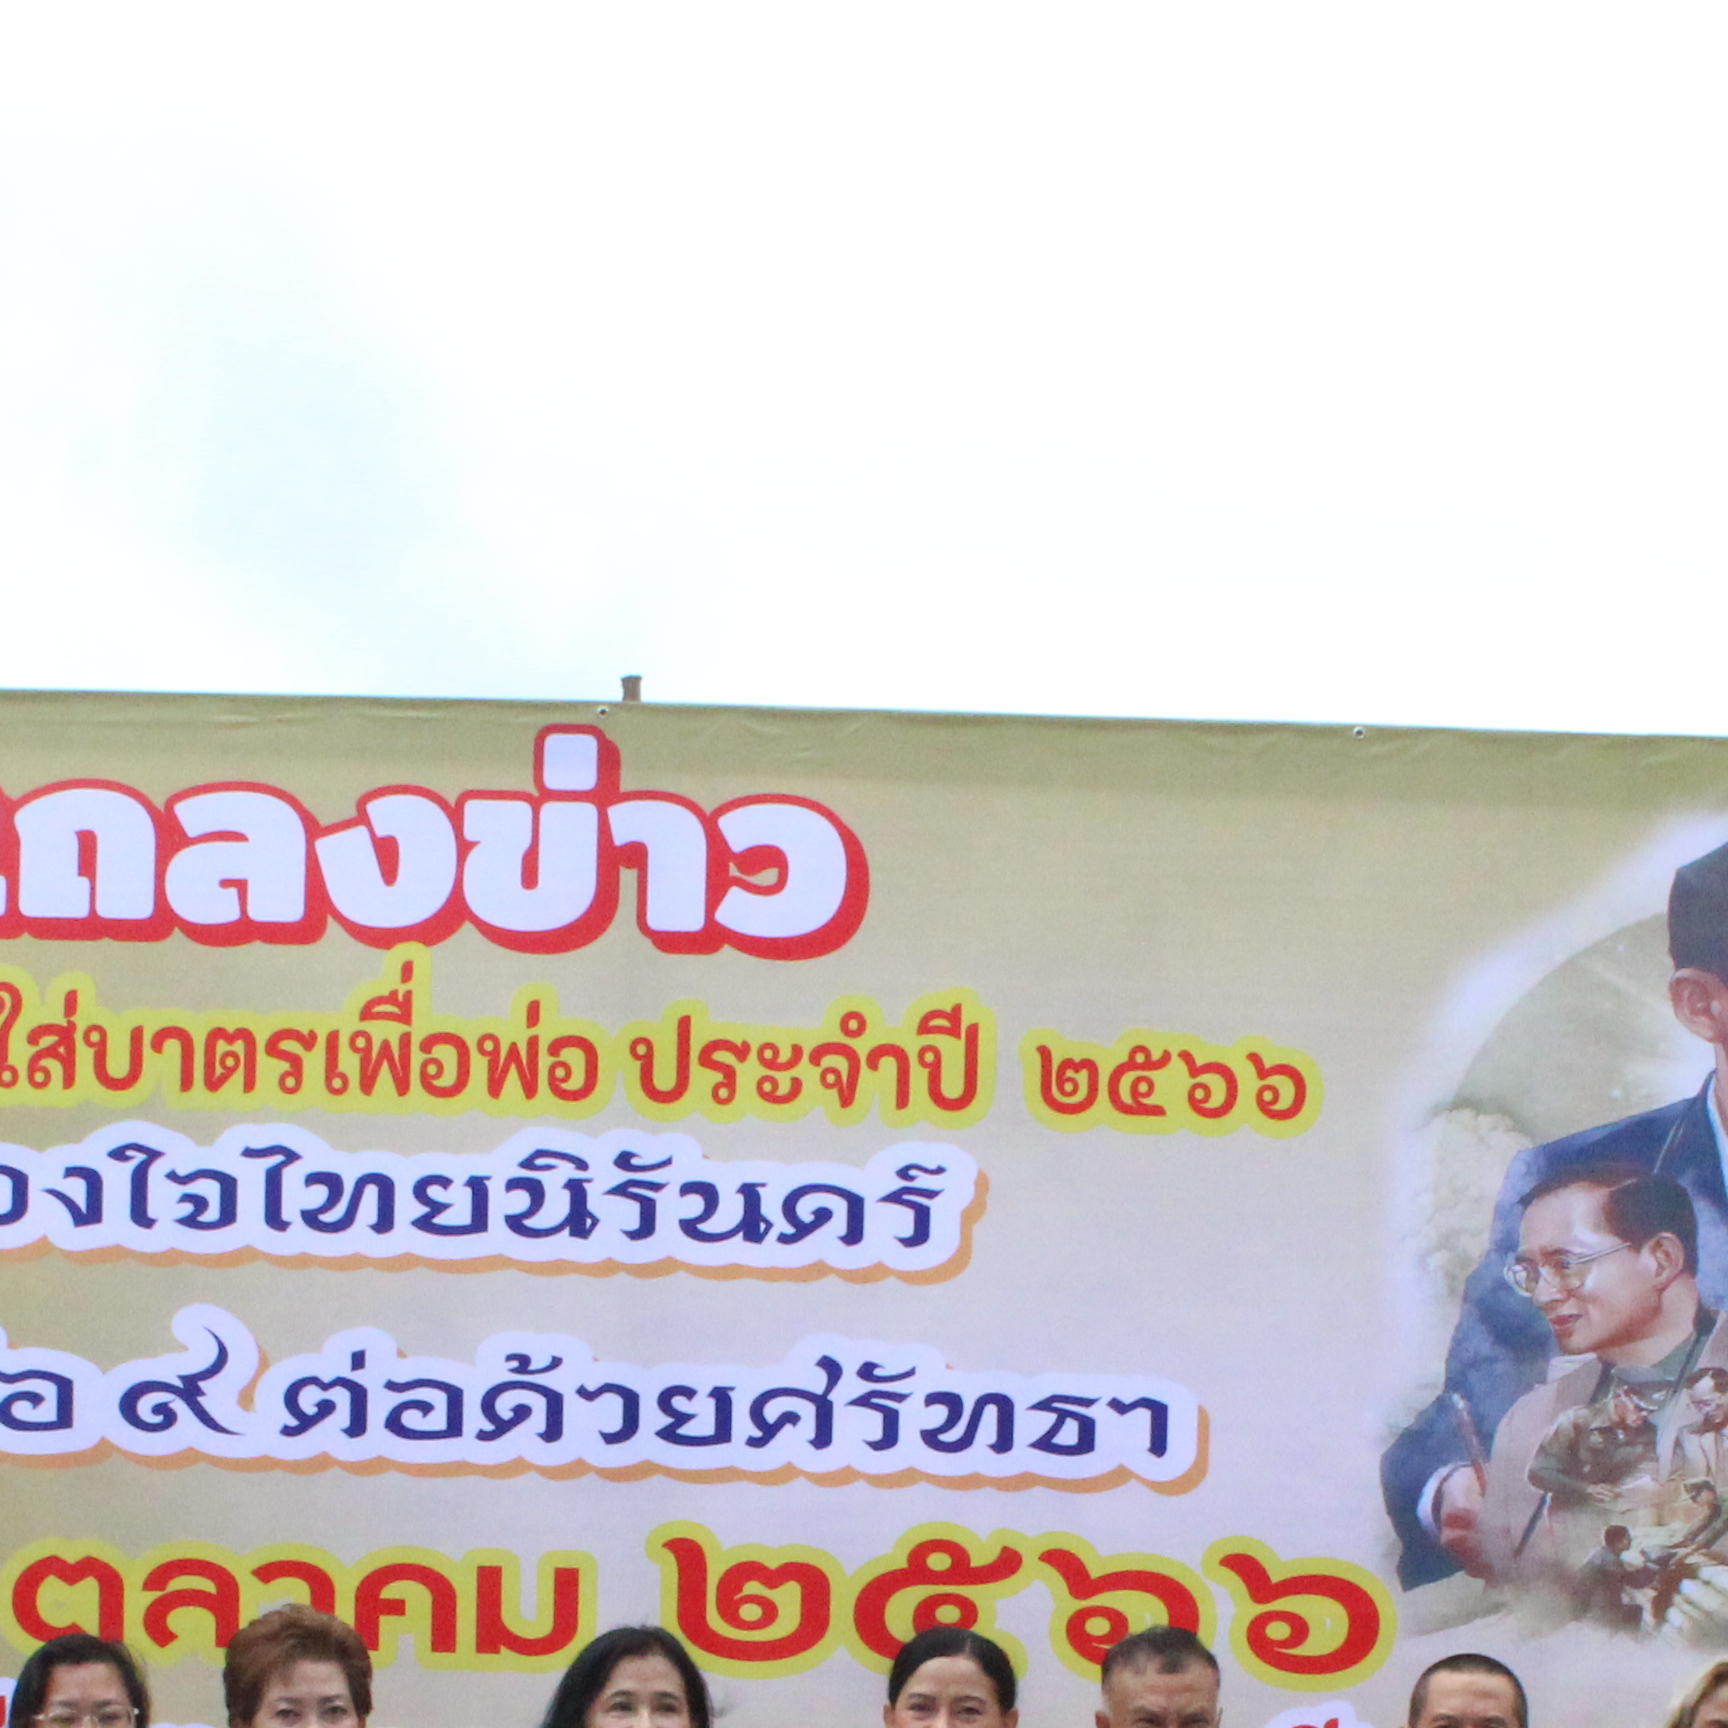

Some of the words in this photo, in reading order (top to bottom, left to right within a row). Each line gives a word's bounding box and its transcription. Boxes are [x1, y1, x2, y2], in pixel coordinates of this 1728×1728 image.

[628, 1003, 981, 1113] ประจำปี
[1034, 1043, 1309, 1122] ๒๕๖๖
[117, 1327, 246, 1435] ๙
[278, 1351, 1170, 1460] ต่อด้วยศรัทธา
[661, 1535, 1381, 1676] ๒๕๖๖
